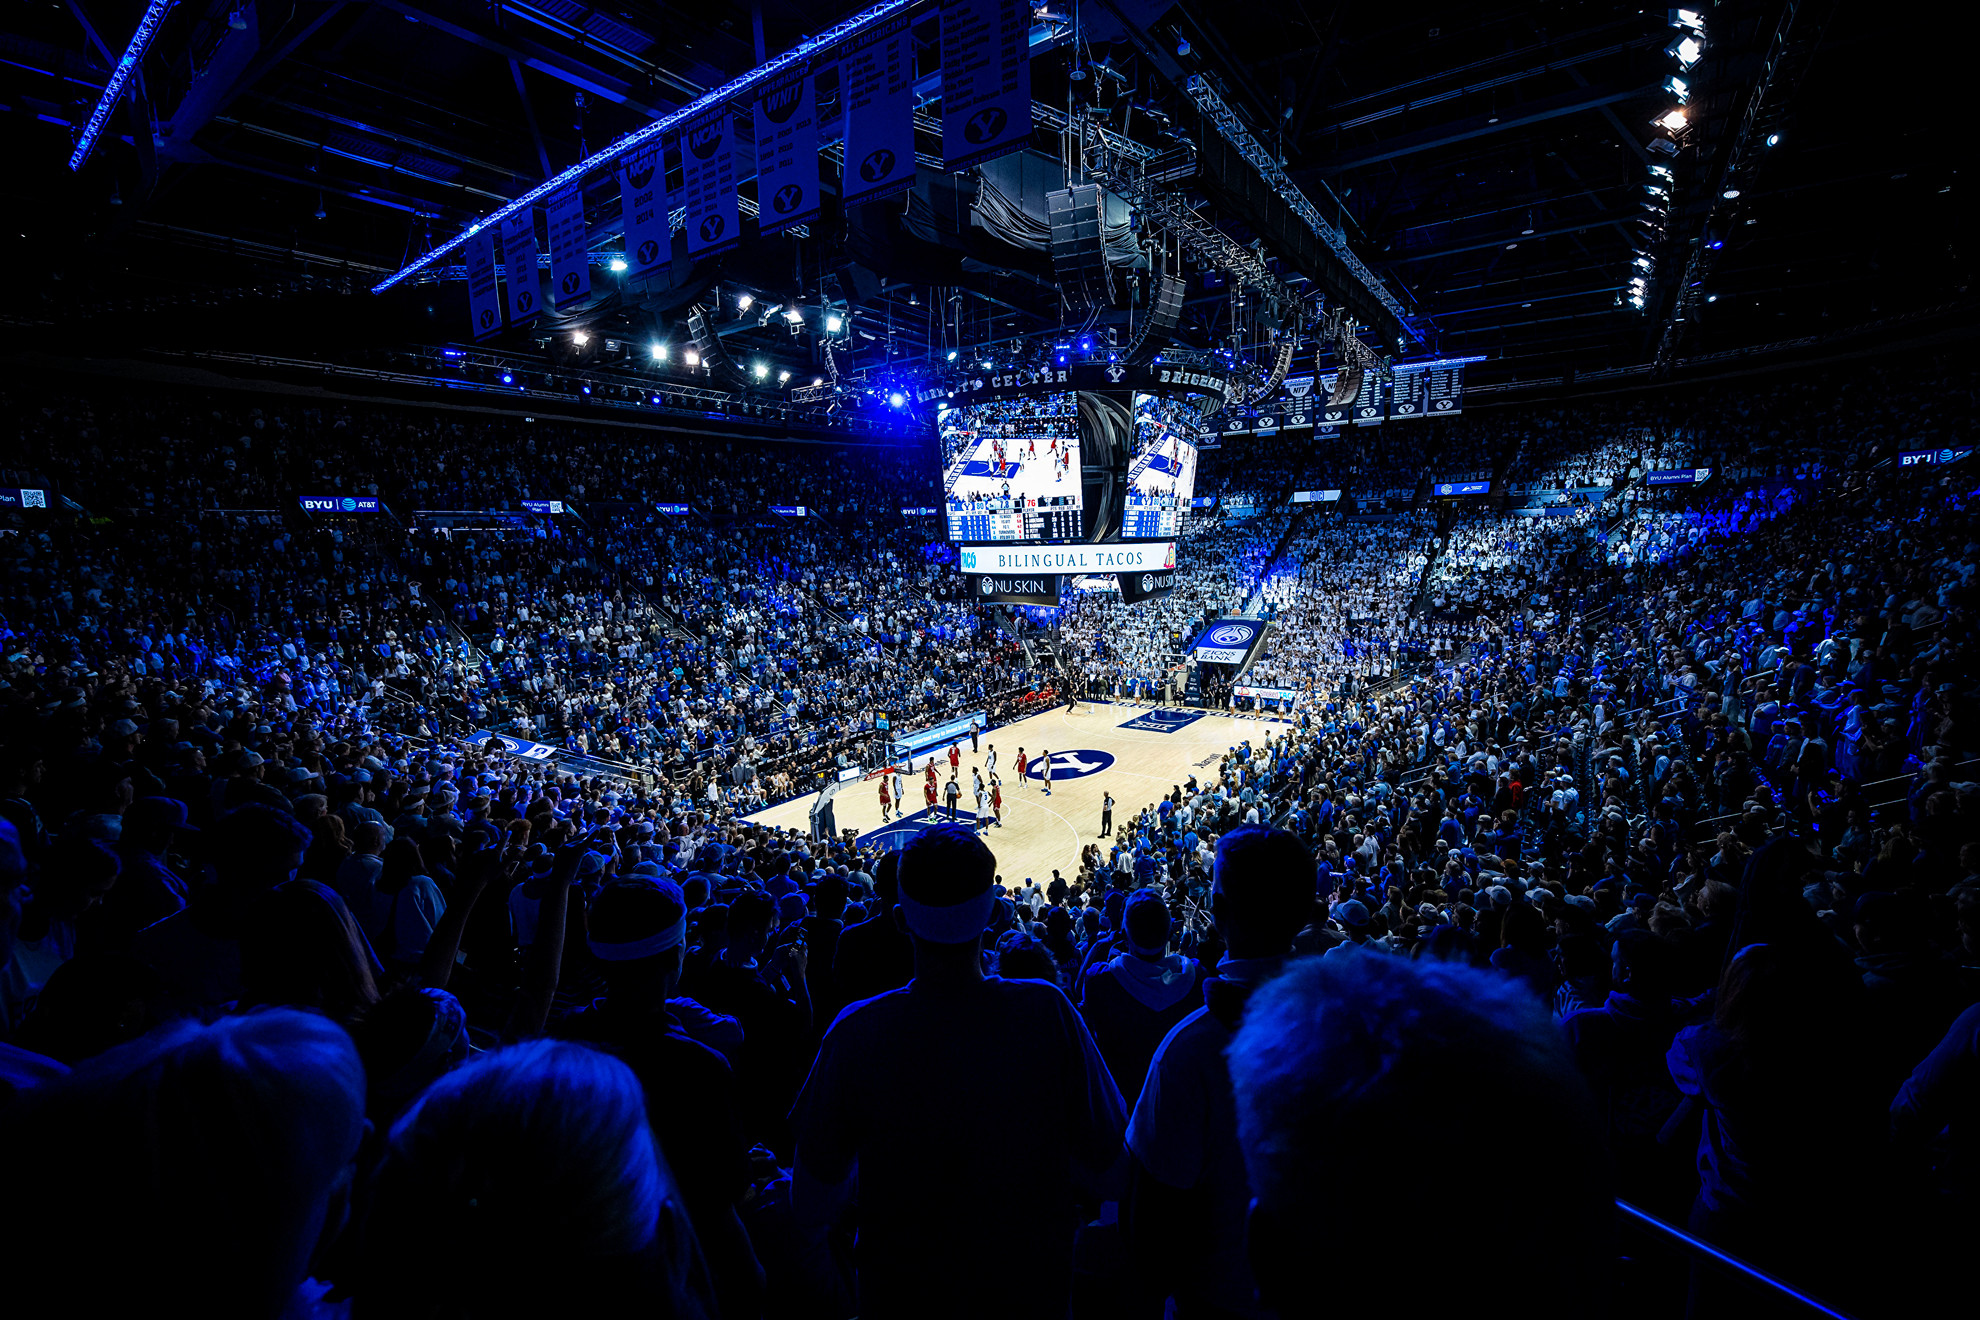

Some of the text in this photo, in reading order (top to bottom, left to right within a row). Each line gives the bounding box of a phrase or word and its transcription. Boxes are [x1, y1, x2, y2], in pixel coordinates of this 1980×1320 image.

[767, 81, 802, 113] WNIT
[970, 110, 1001, 141] Y
[692, 119, 723, 150] NCAA
[629, 155, 656, 180] NCAA
[634, 191, 653, 208] 2002
[636, 209, 654, 225] 2014
[1160, 369, 1224, 391] BRIGHAM
[305, 501, 333, 509] BYU
[1027, 499, 1036, 507] 76
[999, 552, 1143, 567] BILINGUAL TACOS
[995, 580, 1012, 593] NU
